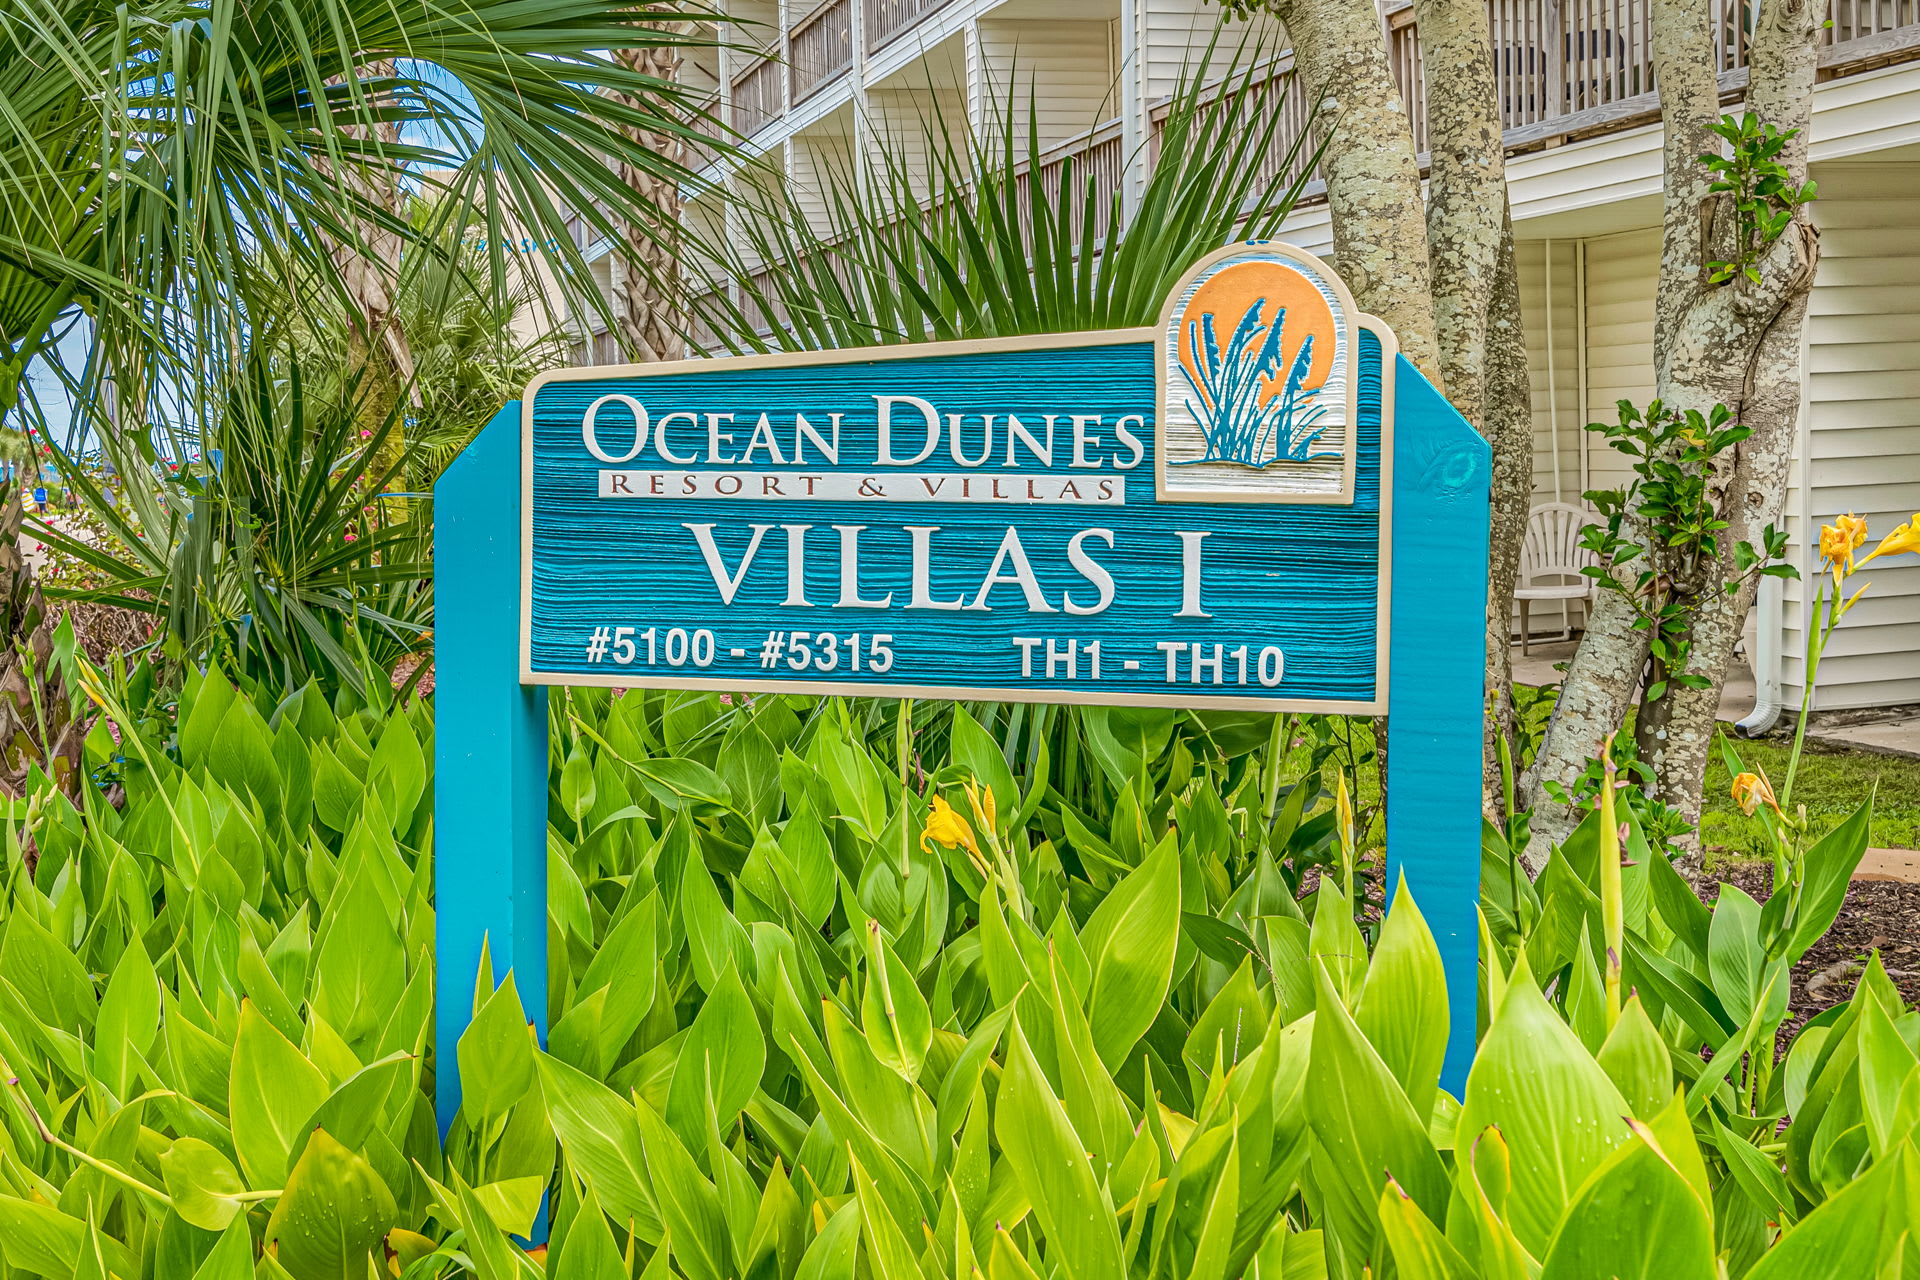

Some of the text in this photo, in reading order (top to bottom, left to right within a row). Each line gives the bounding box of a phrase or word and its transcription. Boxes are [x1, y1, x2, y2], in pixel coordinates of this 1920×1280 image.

[582, 393, 1145, 470] OCEAN DUNES
[610, 474, 1113, 500] RESORT & VILLAS
[681, 522, 1212, 618] VILLAS I
[585, 626, 715, 668] #5100
[759, 630, 894, 673] #5315
[1012, 636, 1101, 680] TH1
[1156, 641, 1285, 688] TH10
